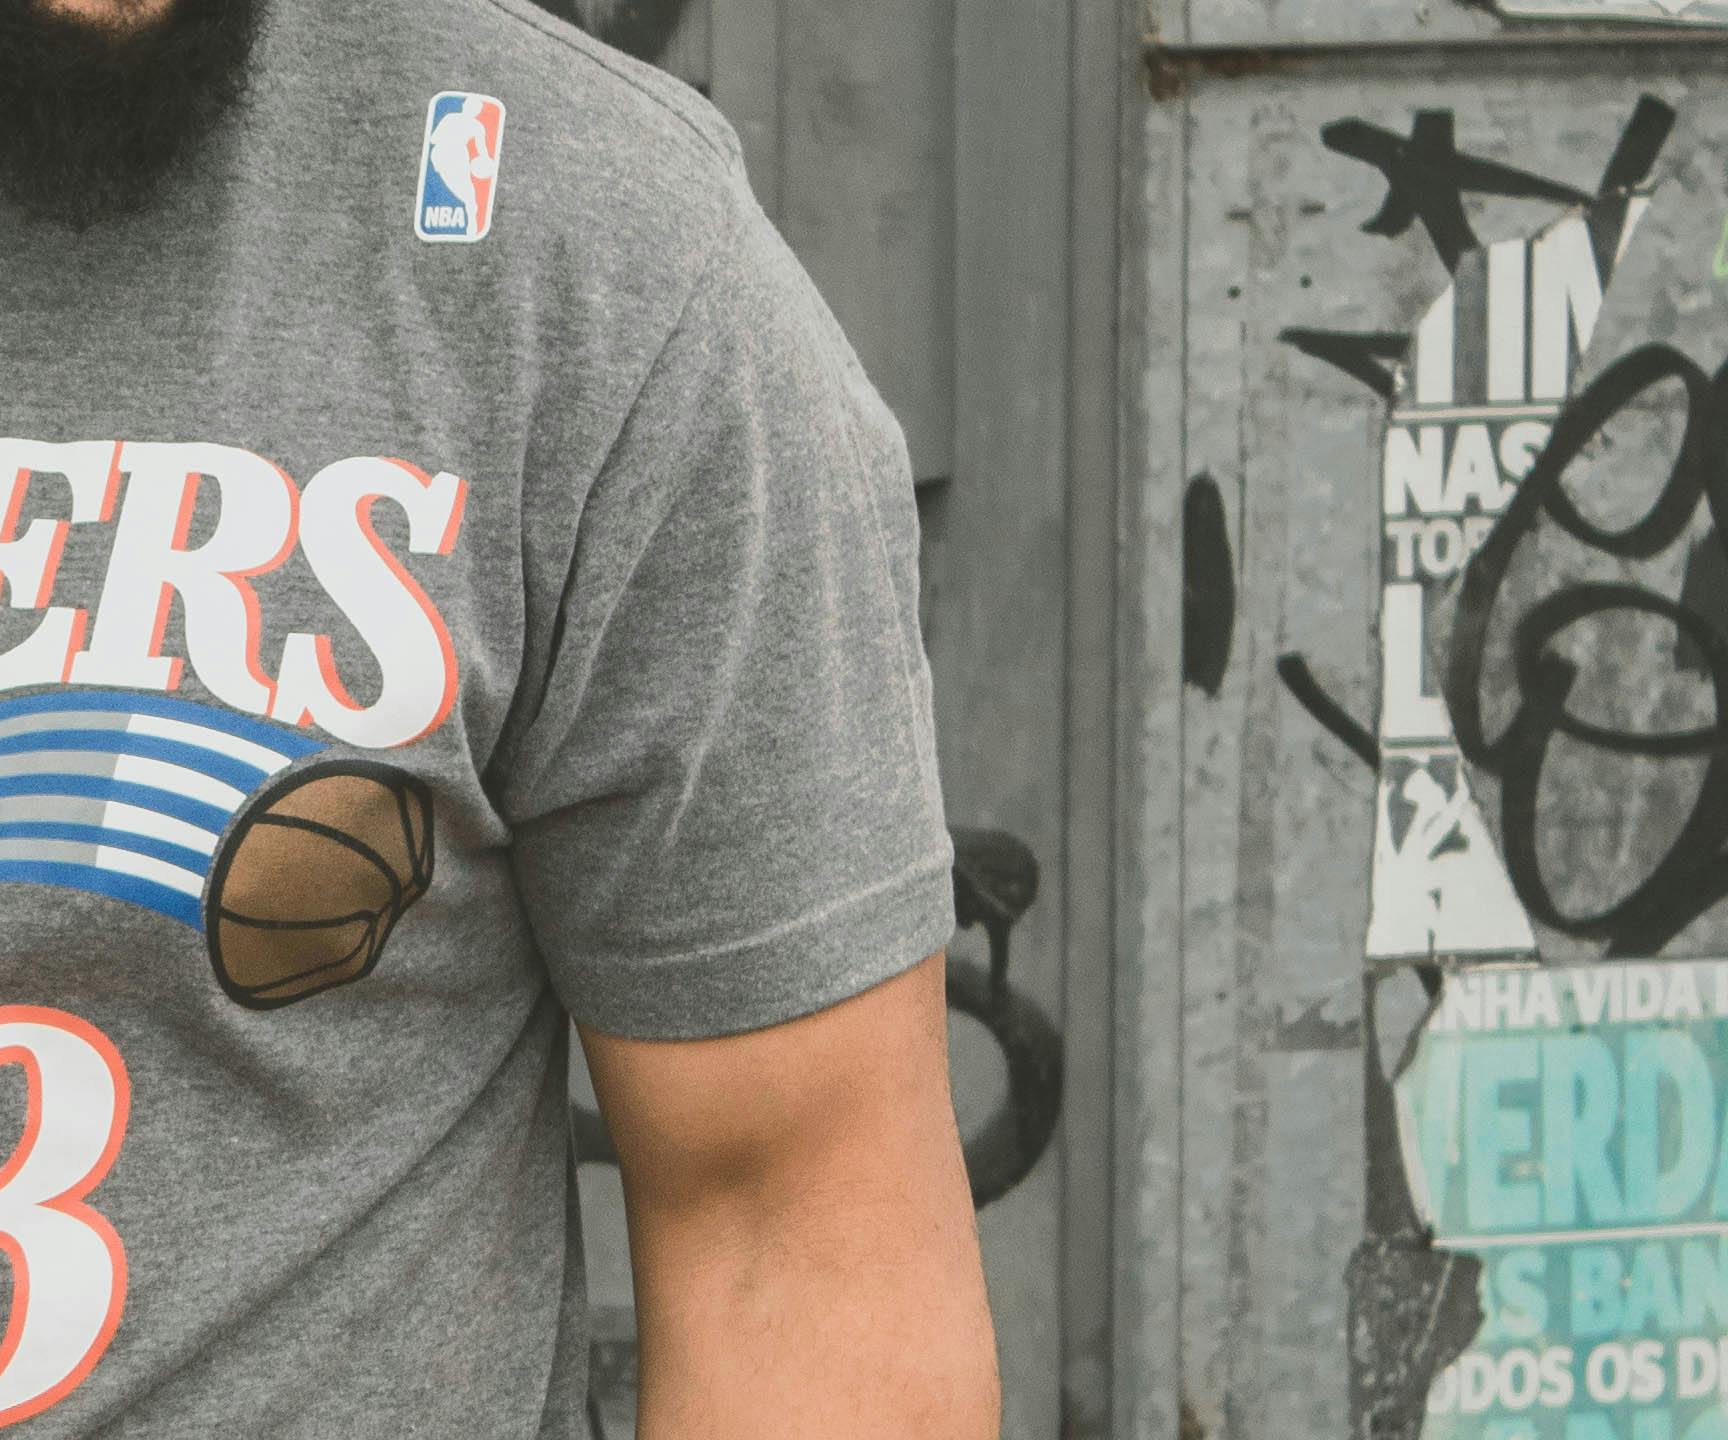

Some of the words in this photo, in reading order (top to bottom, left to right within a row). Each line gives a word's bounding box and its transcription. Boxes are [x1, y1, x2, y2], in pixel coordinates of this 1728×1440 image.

[424, 205, 466, 228] NBA
[1570, 964, 1704, 1025] VIDA
[1585, 1339, 1667, 1404] OS
